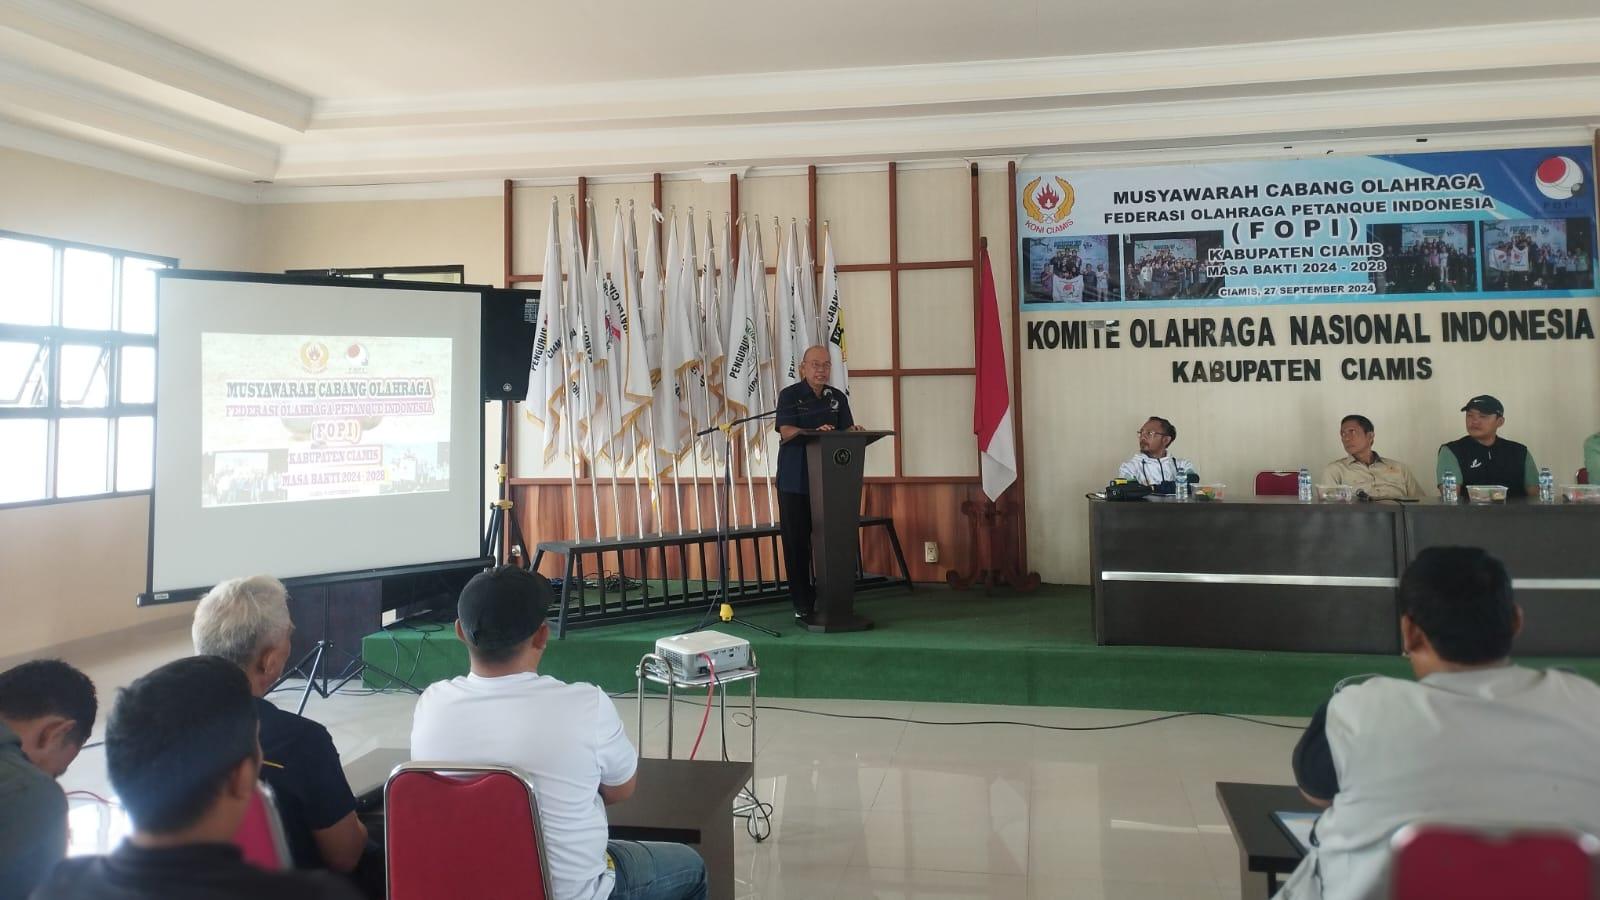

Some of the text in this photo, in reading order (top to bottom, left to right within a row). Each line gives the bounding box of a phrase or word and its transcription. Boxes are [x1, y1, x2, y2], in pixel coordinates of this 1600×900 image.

[1113, 175, 1482, 205] MUSYAWARAH CABANG OLAHRAGA
[1104, 197, 1494, 224] FEDERASI OLAHRAGA PETANQUE INDONESIA
[1024, 219, 1074, 234] KONI CIAMIS
[1209, 244, 1384, 261] KABUPATEN CIAMIS
[1207, 265, 1248, 277] MASA
[1253, 264, 1298, 275] BAKTI
[1302, 262, 1337, 273] 2024
[1350, 261, 1386, 272] 2028
[1220, 284, 1374, 297] CIAMIS, 27 SEPTEMBER 2024
[1027, 308, 1594, 349] KOMITE OLAHRAGA NASIONAL INDONESIA
[1172, 356, 1433, 383] KABUPATEN CIAMIS
[226, 379, 432, 399] MUSYAWARAH CABANG OLAHRAGA
[225, 401, 433, 418] FEDERASI OLAHRAGA PETANQUE INDONESIA
[289, 449, 379, 465] KABUPATEN CIAMIS
[281, 474, 310, 487] MASA
[311, 472, 341, 485] BAKTI
[341, 471, 360, 483] 2024
[366, 470, 385, 481] 2028
